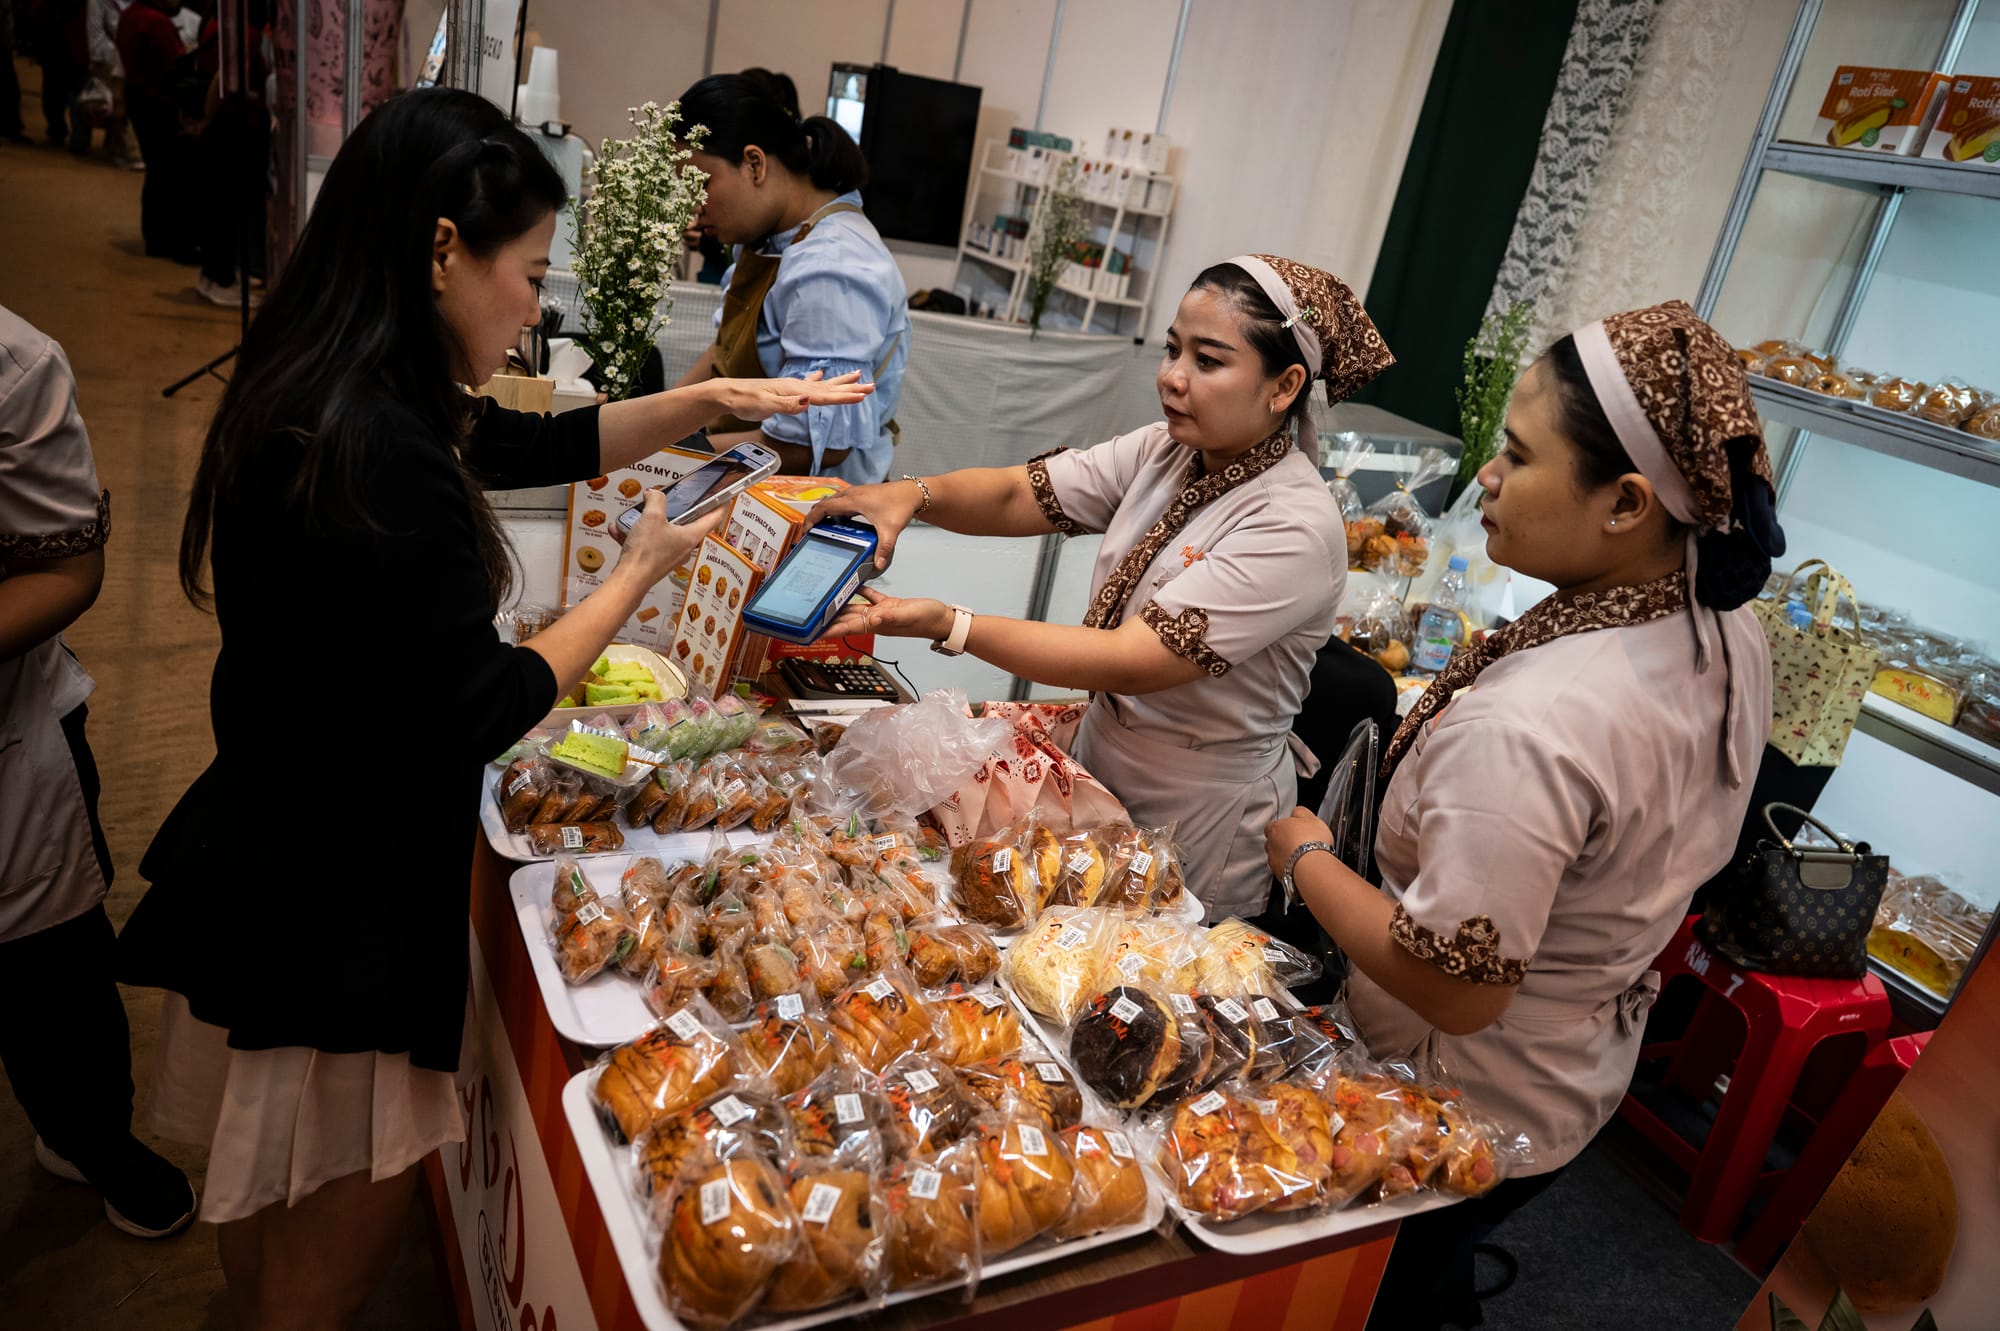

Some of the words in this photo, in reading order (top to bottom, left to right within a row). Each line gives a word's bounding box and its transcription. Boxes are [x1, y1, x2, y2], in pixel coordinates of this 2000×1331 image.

[1849, 86, 1873, 97] Roti
[654, 466, 671, 477] MY
[742, 509, 756, 520] PAKET
[755, 515, 769, 529] SNACK
[767, 525, 777, 537] BOX
[1724, 973, 1745, 998] 7
